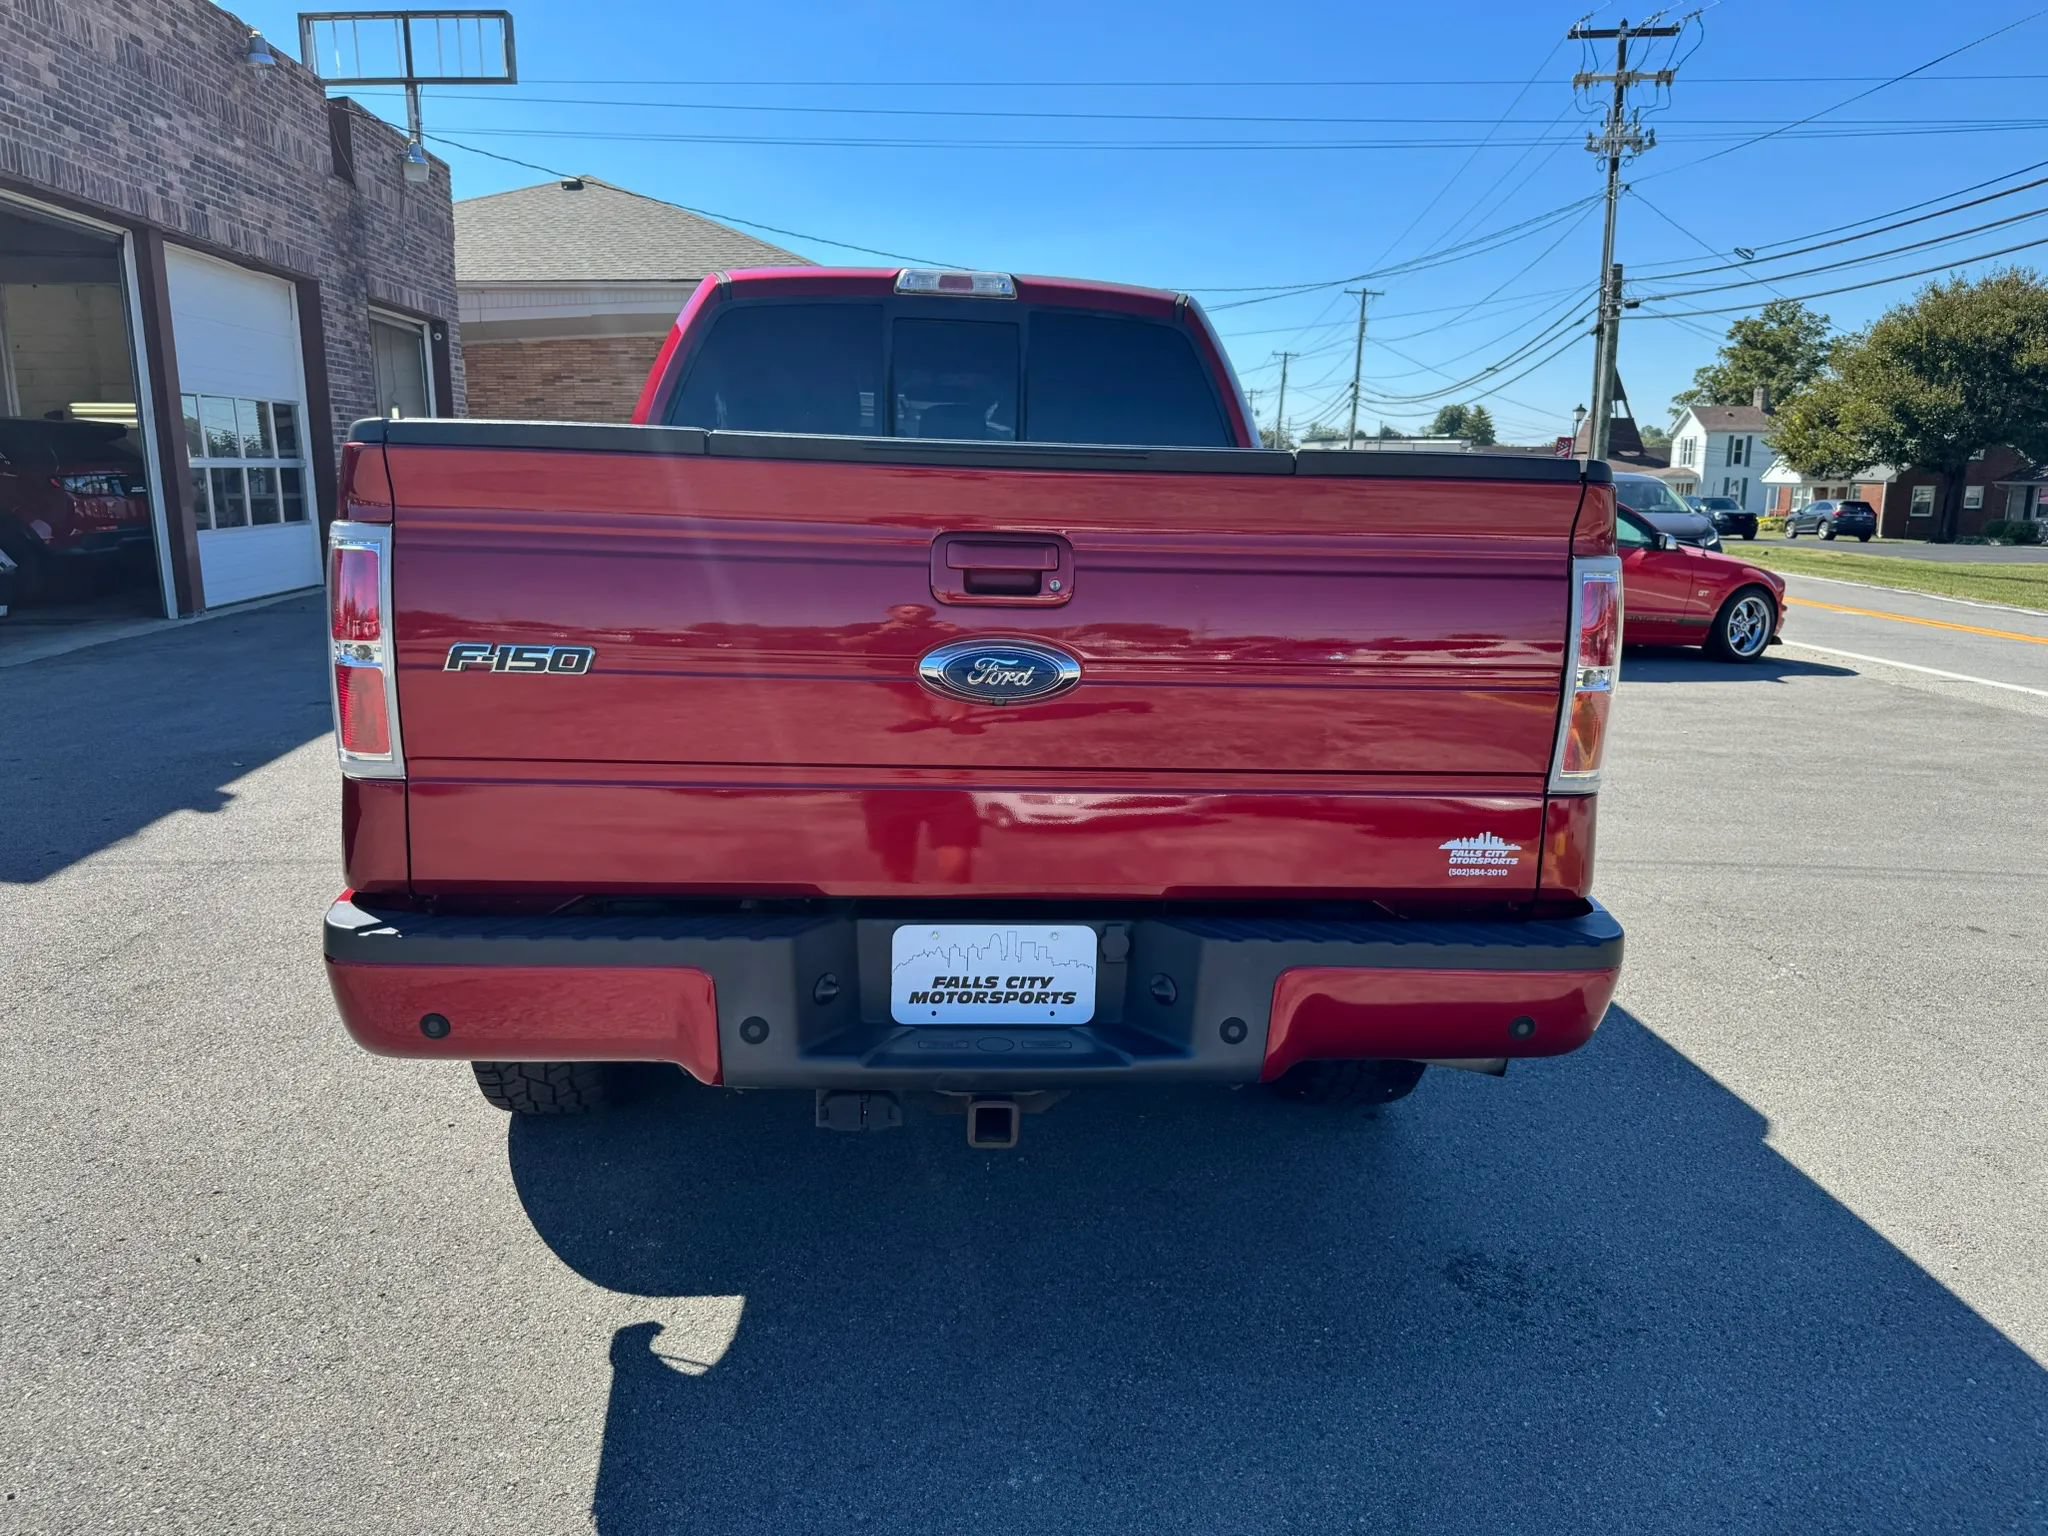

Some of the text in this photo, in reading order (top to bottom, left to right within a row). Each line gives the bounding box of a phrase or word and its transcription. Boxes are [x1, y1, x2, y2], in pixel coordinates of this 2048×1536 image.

[442, 641, 595, 675] F-150
[967, 657, 1036, 687] Ford
[1448, 857, 1519, 865] OTORSPORTS
[1448, 868, 1508, 877] (502)584-2010
[931, 976, 1055, 989] FALLS CITY
[908, 991, 1077, 1004] MOTORSPORTS
